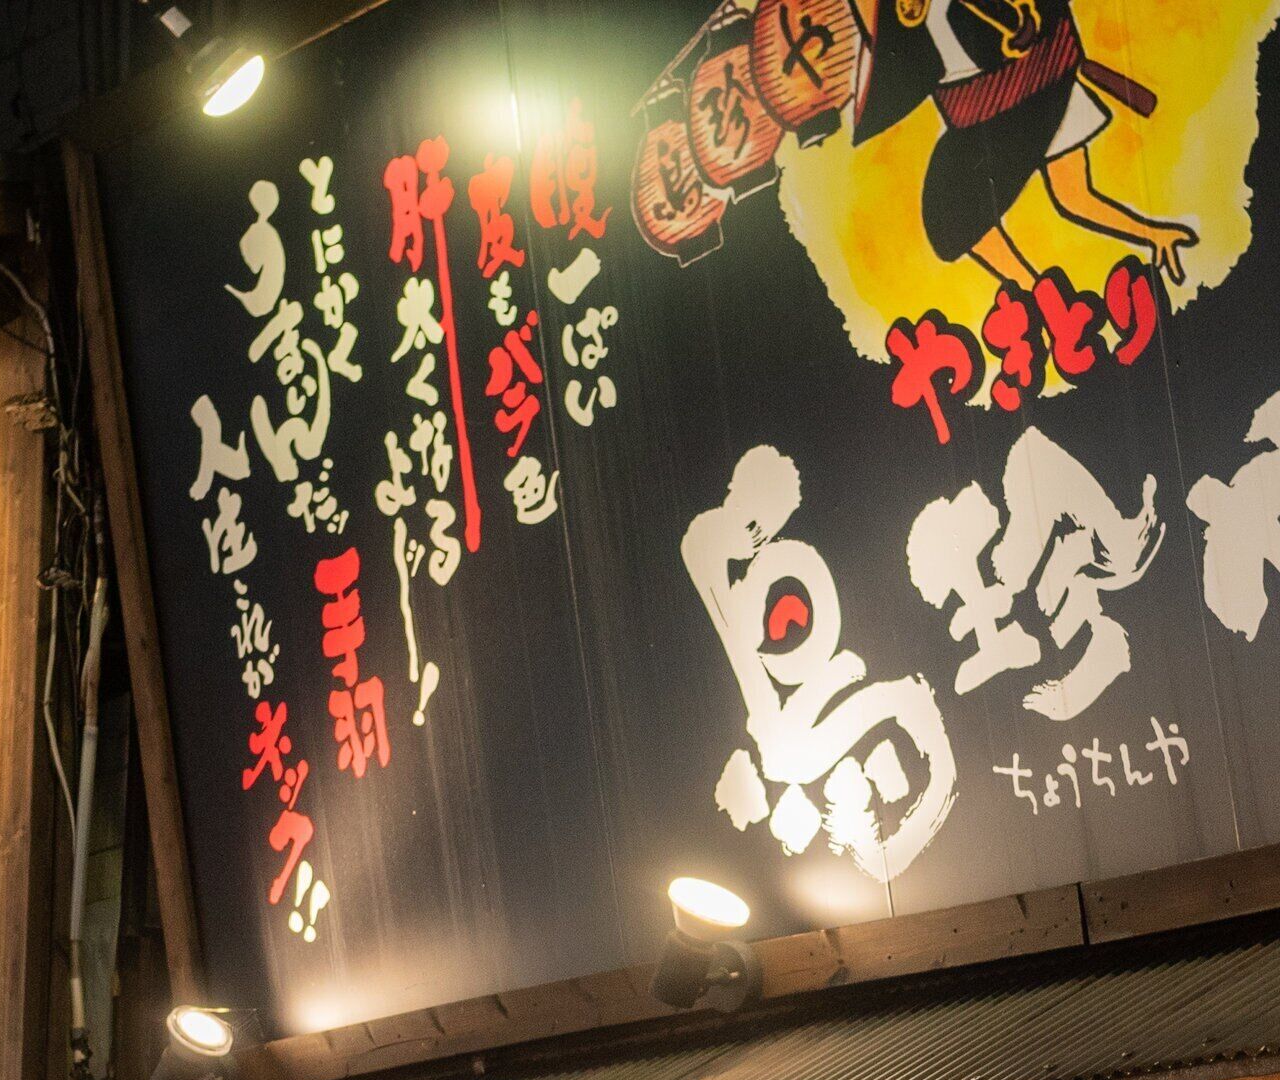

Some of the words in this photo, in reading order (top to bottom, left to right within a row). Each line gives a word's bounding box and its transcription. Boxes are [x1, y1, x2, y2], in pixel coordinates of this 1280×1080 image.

[886, 267, 1157, 444] やきとり
[992, 716, 1190, 815] ちょうちんや
